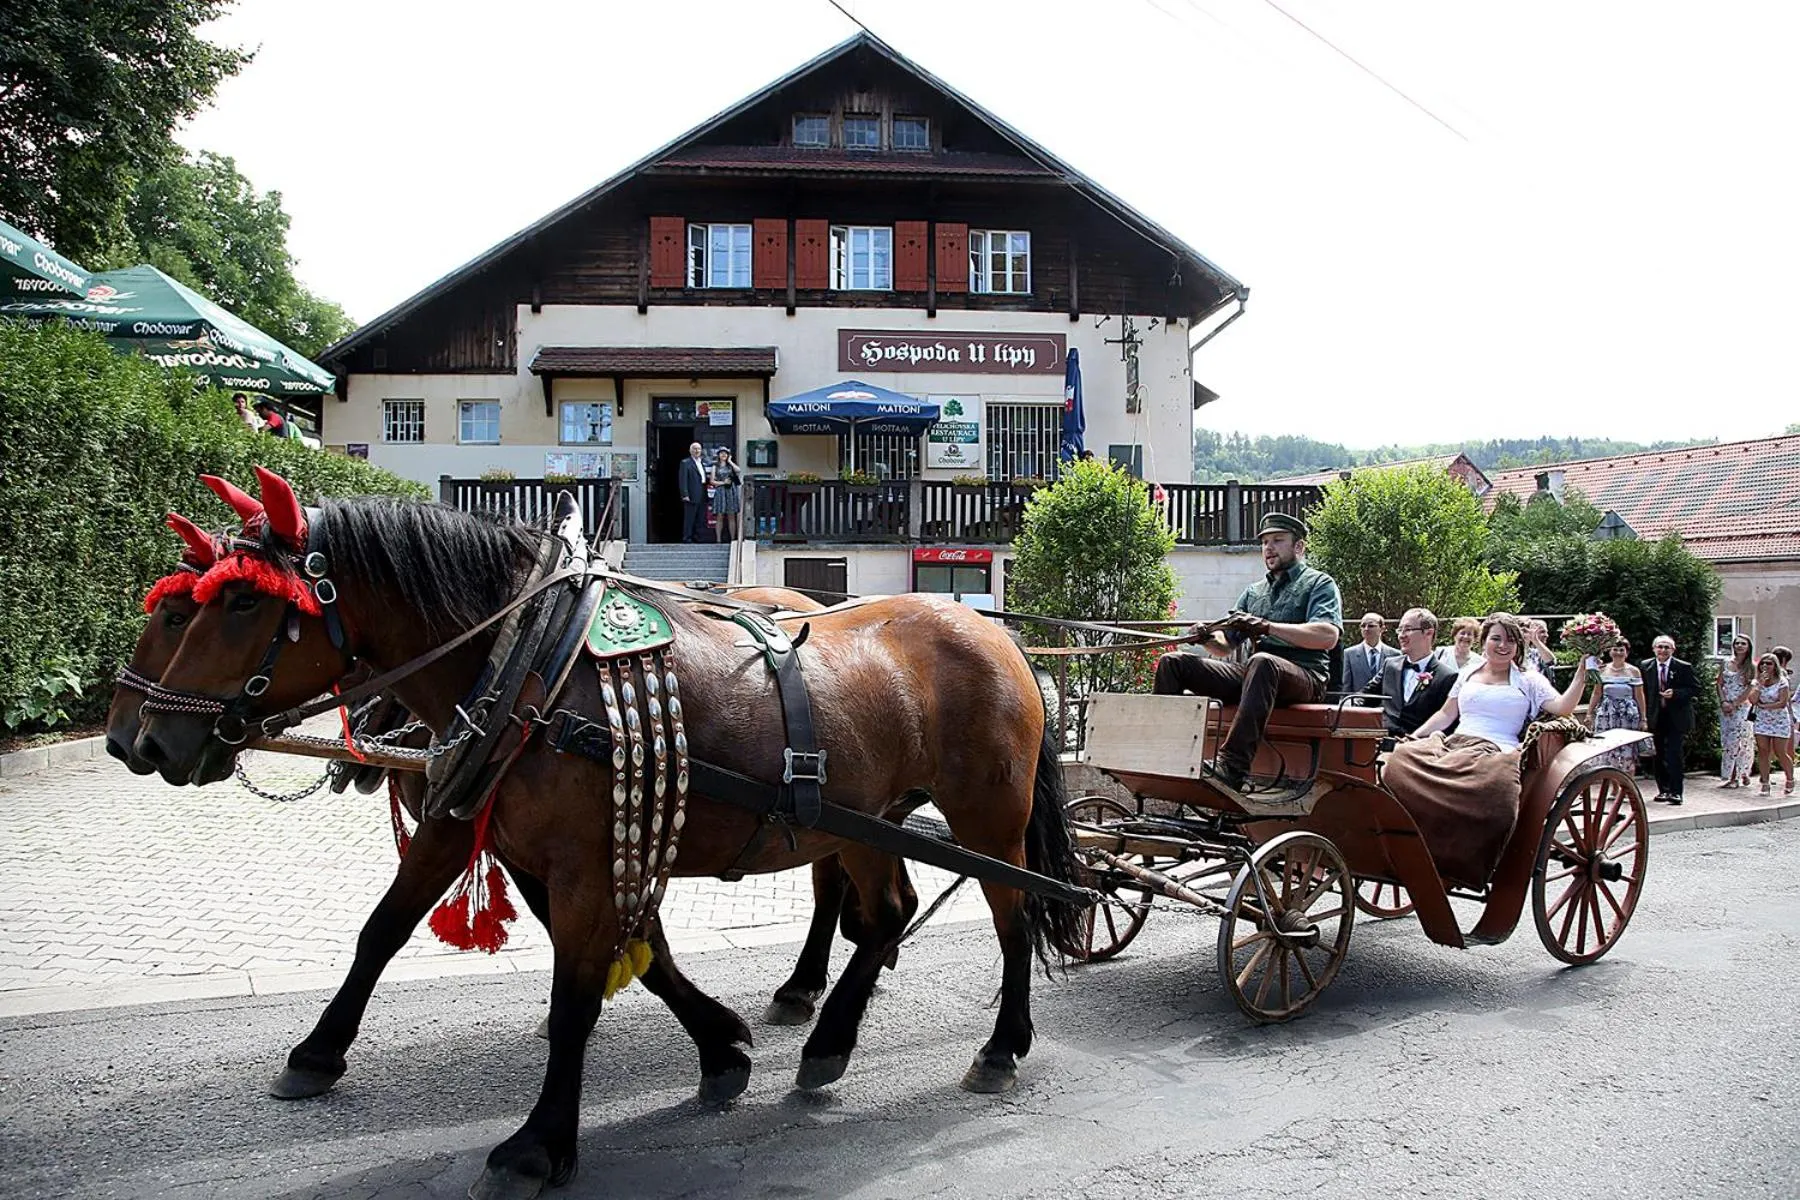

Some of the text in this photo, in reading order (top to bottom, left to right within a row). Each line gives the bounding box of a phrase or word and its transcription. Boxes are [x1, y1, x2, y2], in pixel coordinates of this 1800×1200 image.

[34, 252, 85, 289] Chobovar
[132, 321, 193, 335] Chobovar
[860, 340, 961, 367] Hospoda
[968, 343, 986, 363] U
[787, 402, 831, 413] MATTONI
[877, 403, 921, 415] MATTONI
